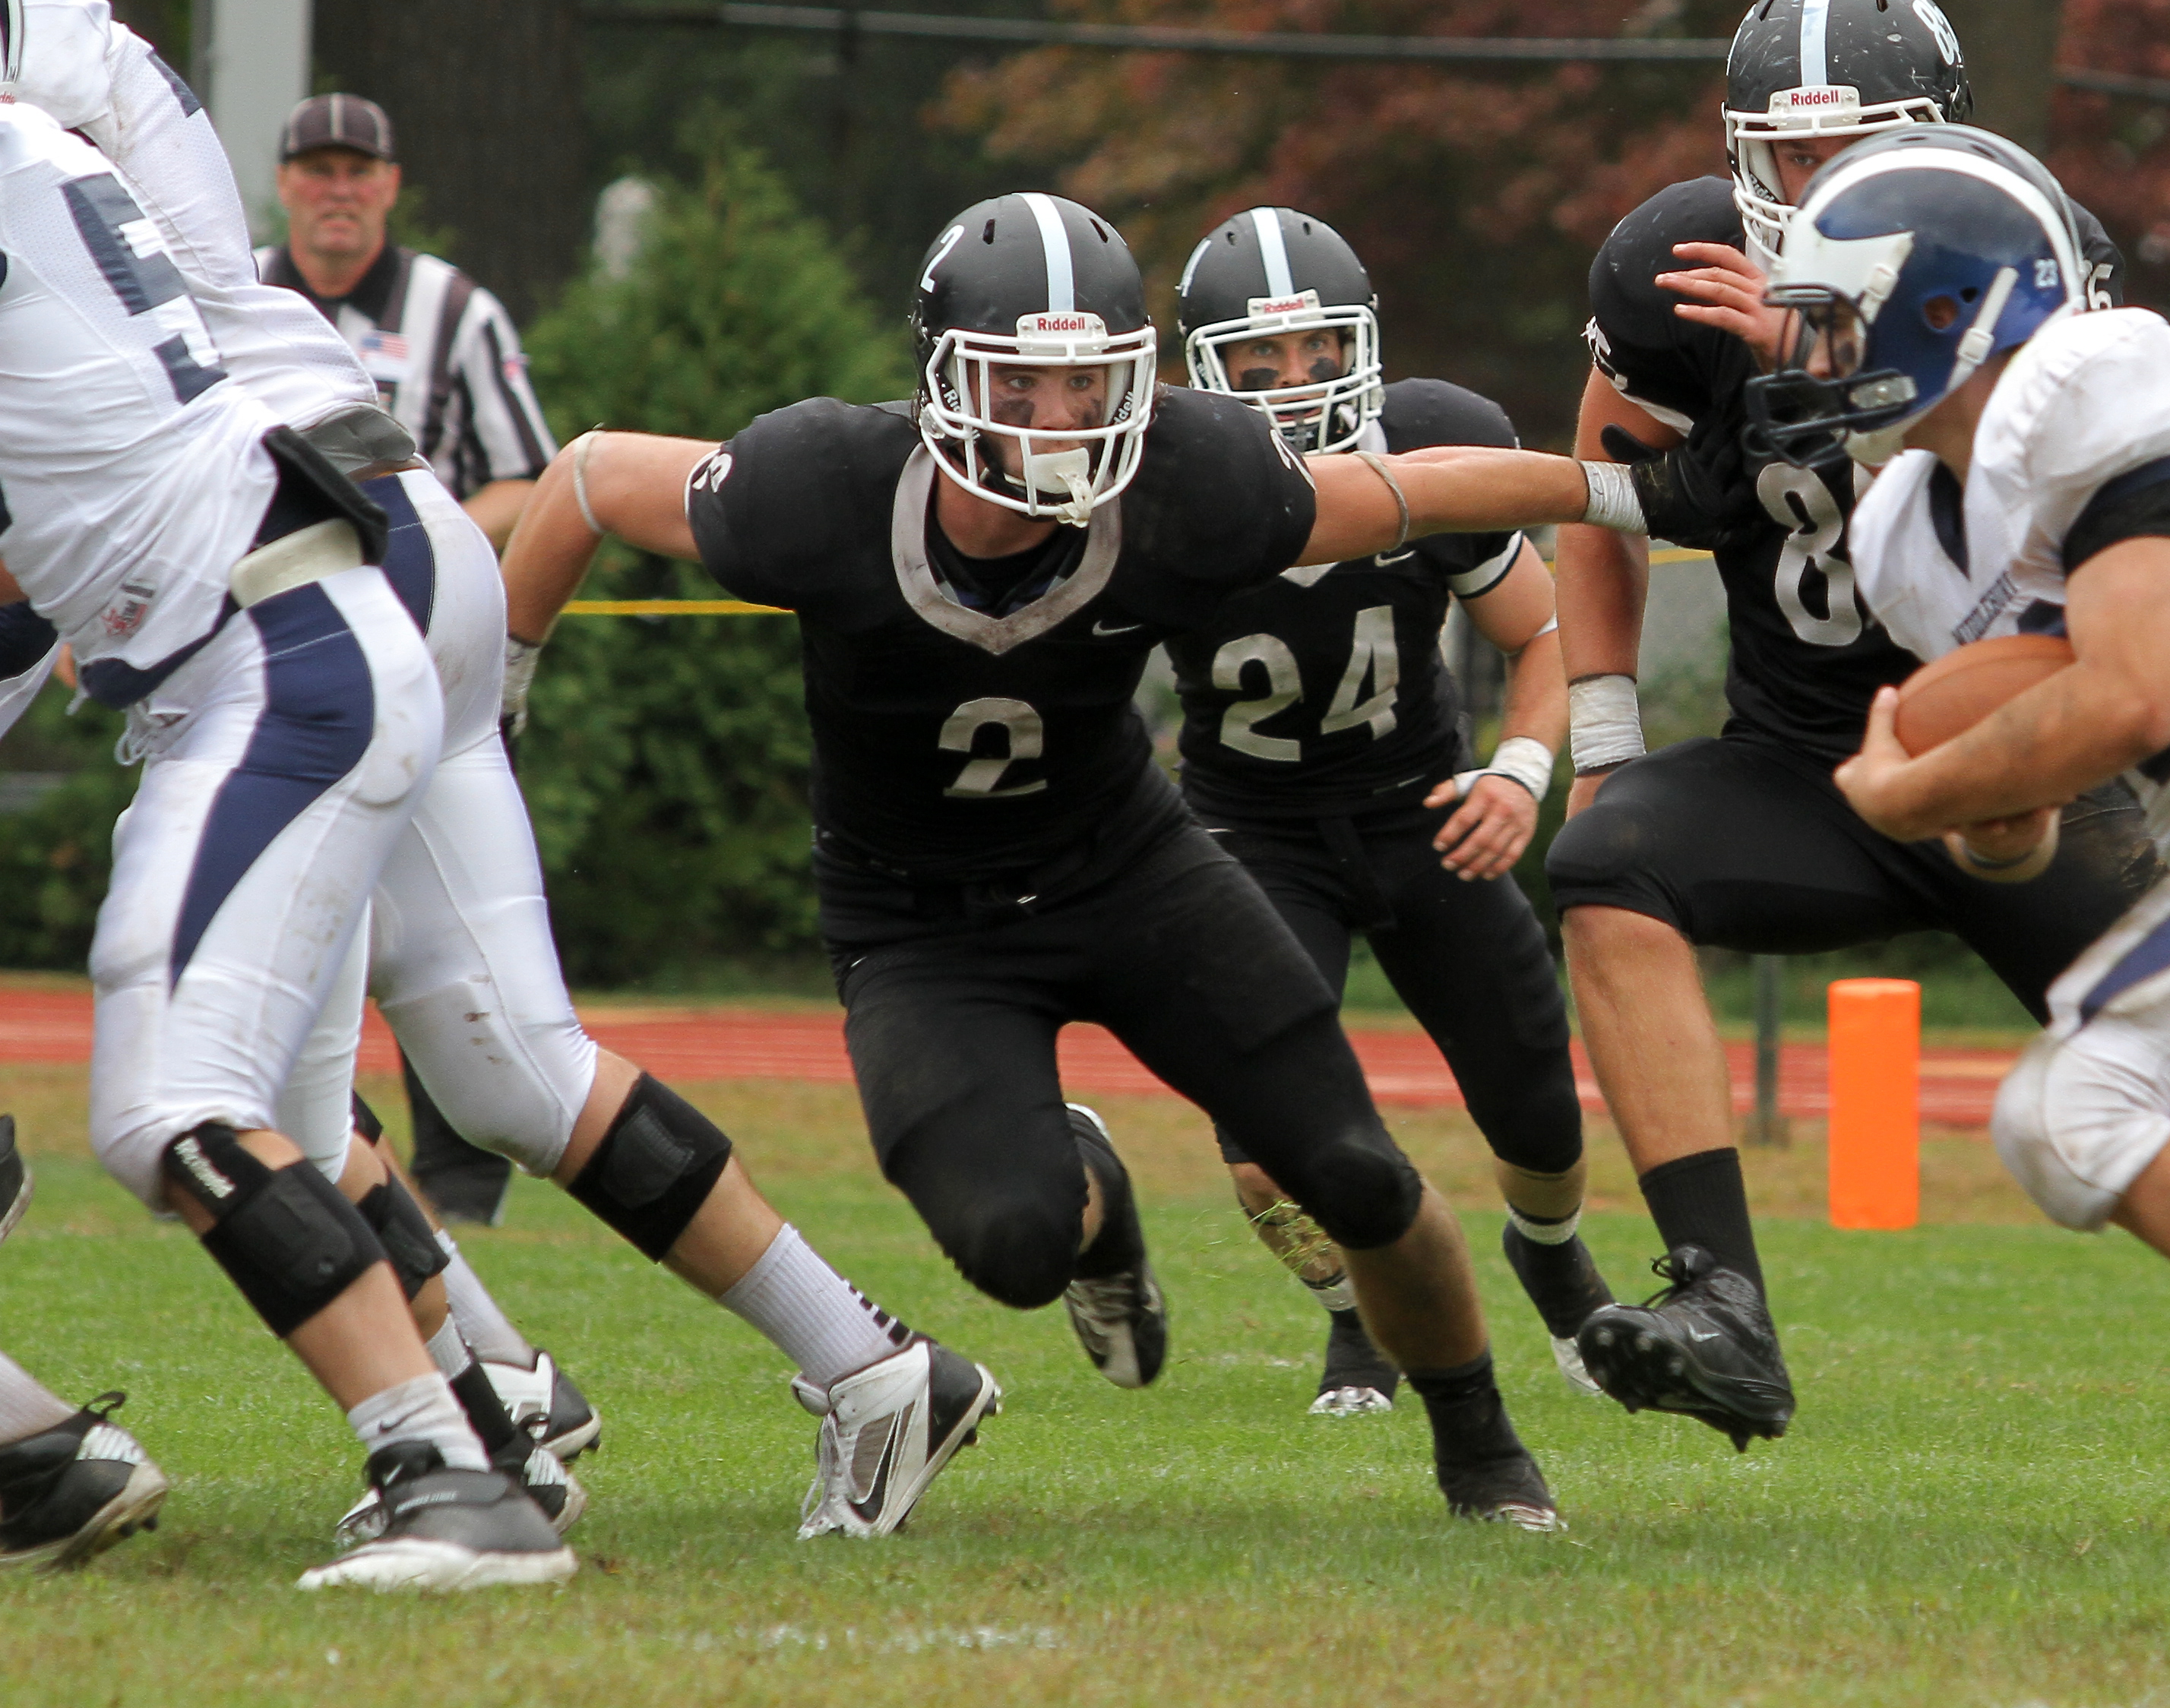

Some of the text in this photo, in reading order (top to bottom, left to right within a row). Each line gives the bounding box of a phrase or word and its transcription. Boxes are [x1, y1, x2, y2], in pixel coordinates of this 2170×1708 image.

[1790, 90, 1839, 106] Riddell
[919, 225, 965, 293] 2
[2035, 258, 2058, 288] 23
[1037, 317, 1085, 331] Riddell
[1212, 605, 1400, 762] 24
[938, 697, 1048, 797] 2
